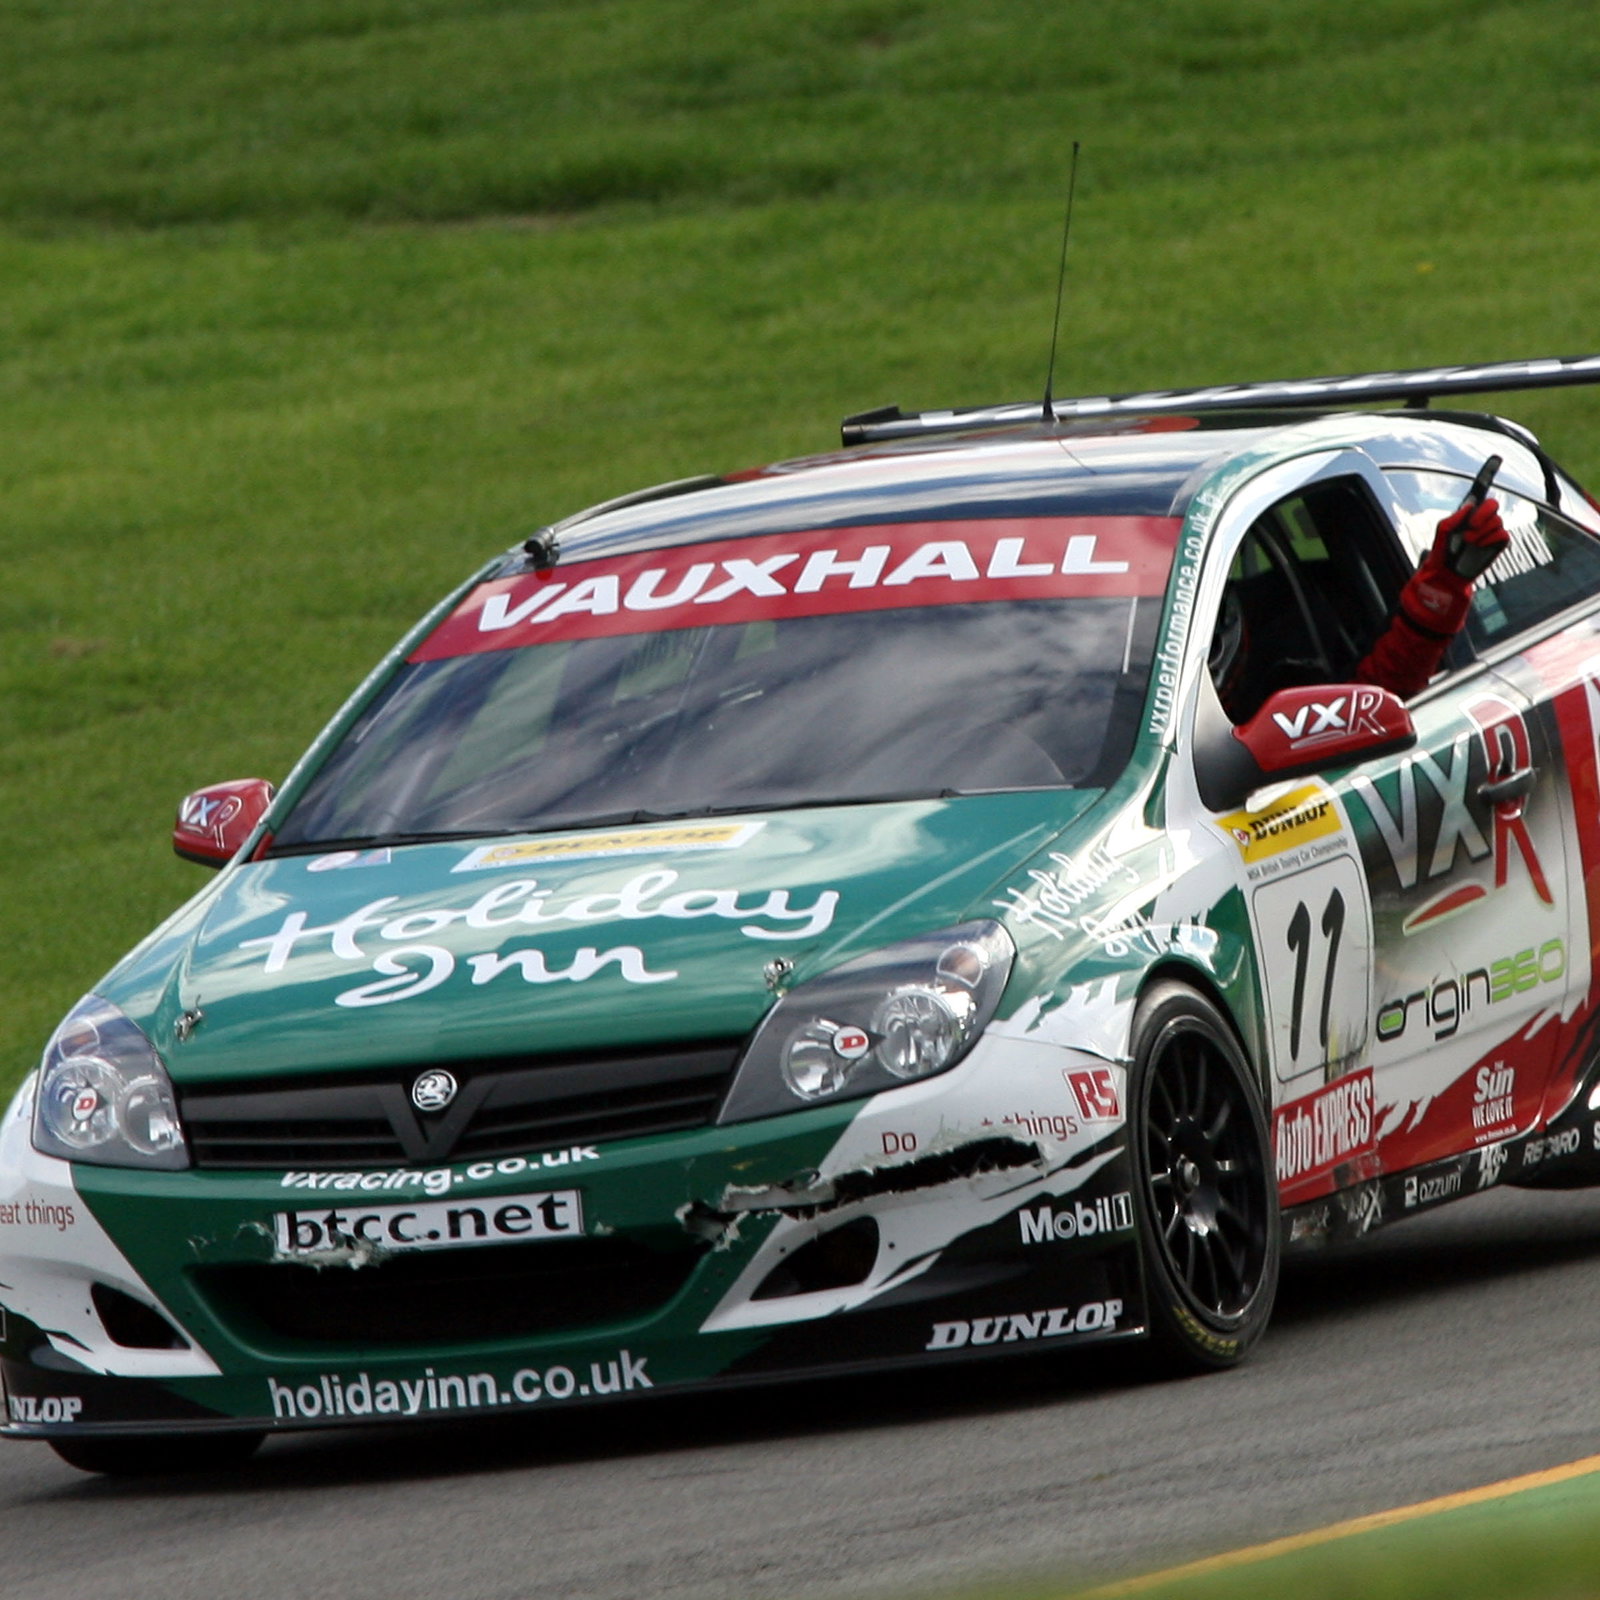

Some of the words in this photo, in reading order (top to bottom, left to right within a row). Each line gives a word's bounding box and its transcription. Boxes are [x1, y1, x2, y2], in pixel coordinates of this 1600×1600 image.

[478, 535, 1129, 631] VAUXHALL
[1272, 690, 1388, 739] VXR
[181, 796, 242, 849] VXR
[1248, 801, 1330, 841] DUNLOP
[1350, 691, 1554, 906] VXR
[239, 870, 839, 974] Holiday
[335, 945, 678, 1007] Inn
[1287, 887, 1346, 1061] 11
[1376, 937, 1567, 1042] origin360
[1067, 1070, 1119, 1119] RS
[1474, 1066, 1515, 1103] Sun
[1314, 1076, 1371, 1166] EXPRESS
[1472, 1104, 1485, 1129] WE
[1485, 1098, 1505, 1125] LOVE
[882, 1132, 917, 1155] Do
[280, 1145, 600, 1195] vxracing.co.uk
[26, 1198, 75, 1232] things
[287, 1193, 570, 1250] btcc.net
[1019, 1197, 1112, 1244] Mobil
[926, 1299, 1123, 1350] DUNLOP
[268, 1350, 654, 1417] holidayinn.co.uk
